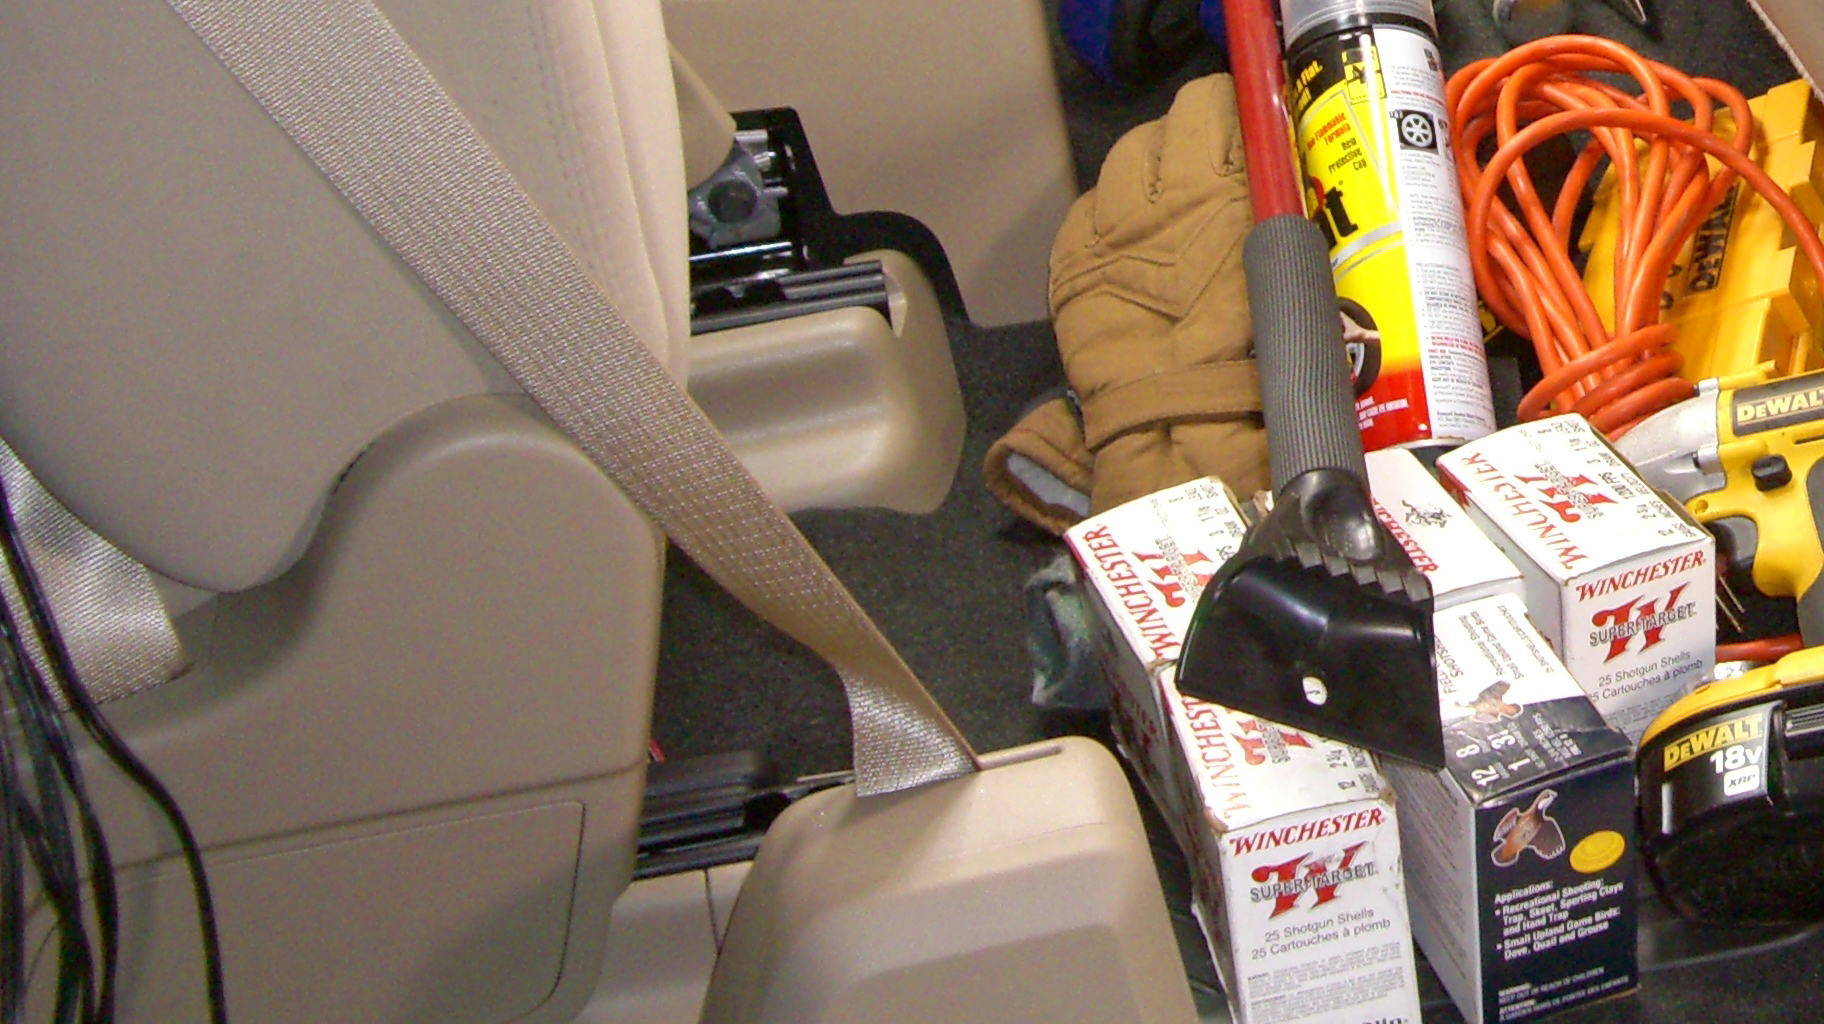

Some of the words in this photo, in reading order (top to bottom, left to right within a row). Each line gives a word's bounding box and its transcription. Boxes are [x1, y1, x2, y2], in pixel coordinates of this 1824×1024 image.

[1461, 451, 1588, 570] WINCHESTER
[1082, 525, 1181, 659] WINCHESTER
[1576, 550, 1704, 603] WINCHESTER
[1599, 675, 1612, 687] 25
[1615, 662, 1657, 683] Shotgun
[1661, 650, 1691, 667] Shells
[1602, 675, 1665, 701] Cartouches
[1673, 660, 1703, 680] plomb
[1182, 696, 1251, 819] WINCHEST
[1455, 744, 1480, 759] 8
[1664, 713, 1762, 772] DEWALT
[1471, 764, 1500, 787] 12
[1728, 775, 1755, 788] XRP
[1229, 807, 1384, 857] WINCHESTER
[1495, 880, 1553, 904] Applications:
[1503, 891, 1560, 916] Recreational
[1560, 891, 1597, 910] Sporting
[1599, 882, 1624, 897] Clays
[1252, 949, 1267, 960] 25
[1270, 930, 1339, 955] Cartouches
[1343, 926, 1350, 937] à
[1354, 919, 1391, 937] plomb
[1265, 930, 1280, 943] 25
[1284, 919, 1334, 939] Shotgun
[1337, 908, 1374, 925] Shells
[1503, 925, 1521, 937] and
[1522, 916, 1546, 931] Hand
[1548, 910, 1569, 923] Trap
[1504, 934, 1531, 950] Small
[1533, 923, 1564, 942] Upland
[1566, 916, 1592, 931] Game
[1533, 937, 1557, 952] Quail
[1559, 932, 1576, 944] and
[1577, 921, 1609, 938] Grouse
